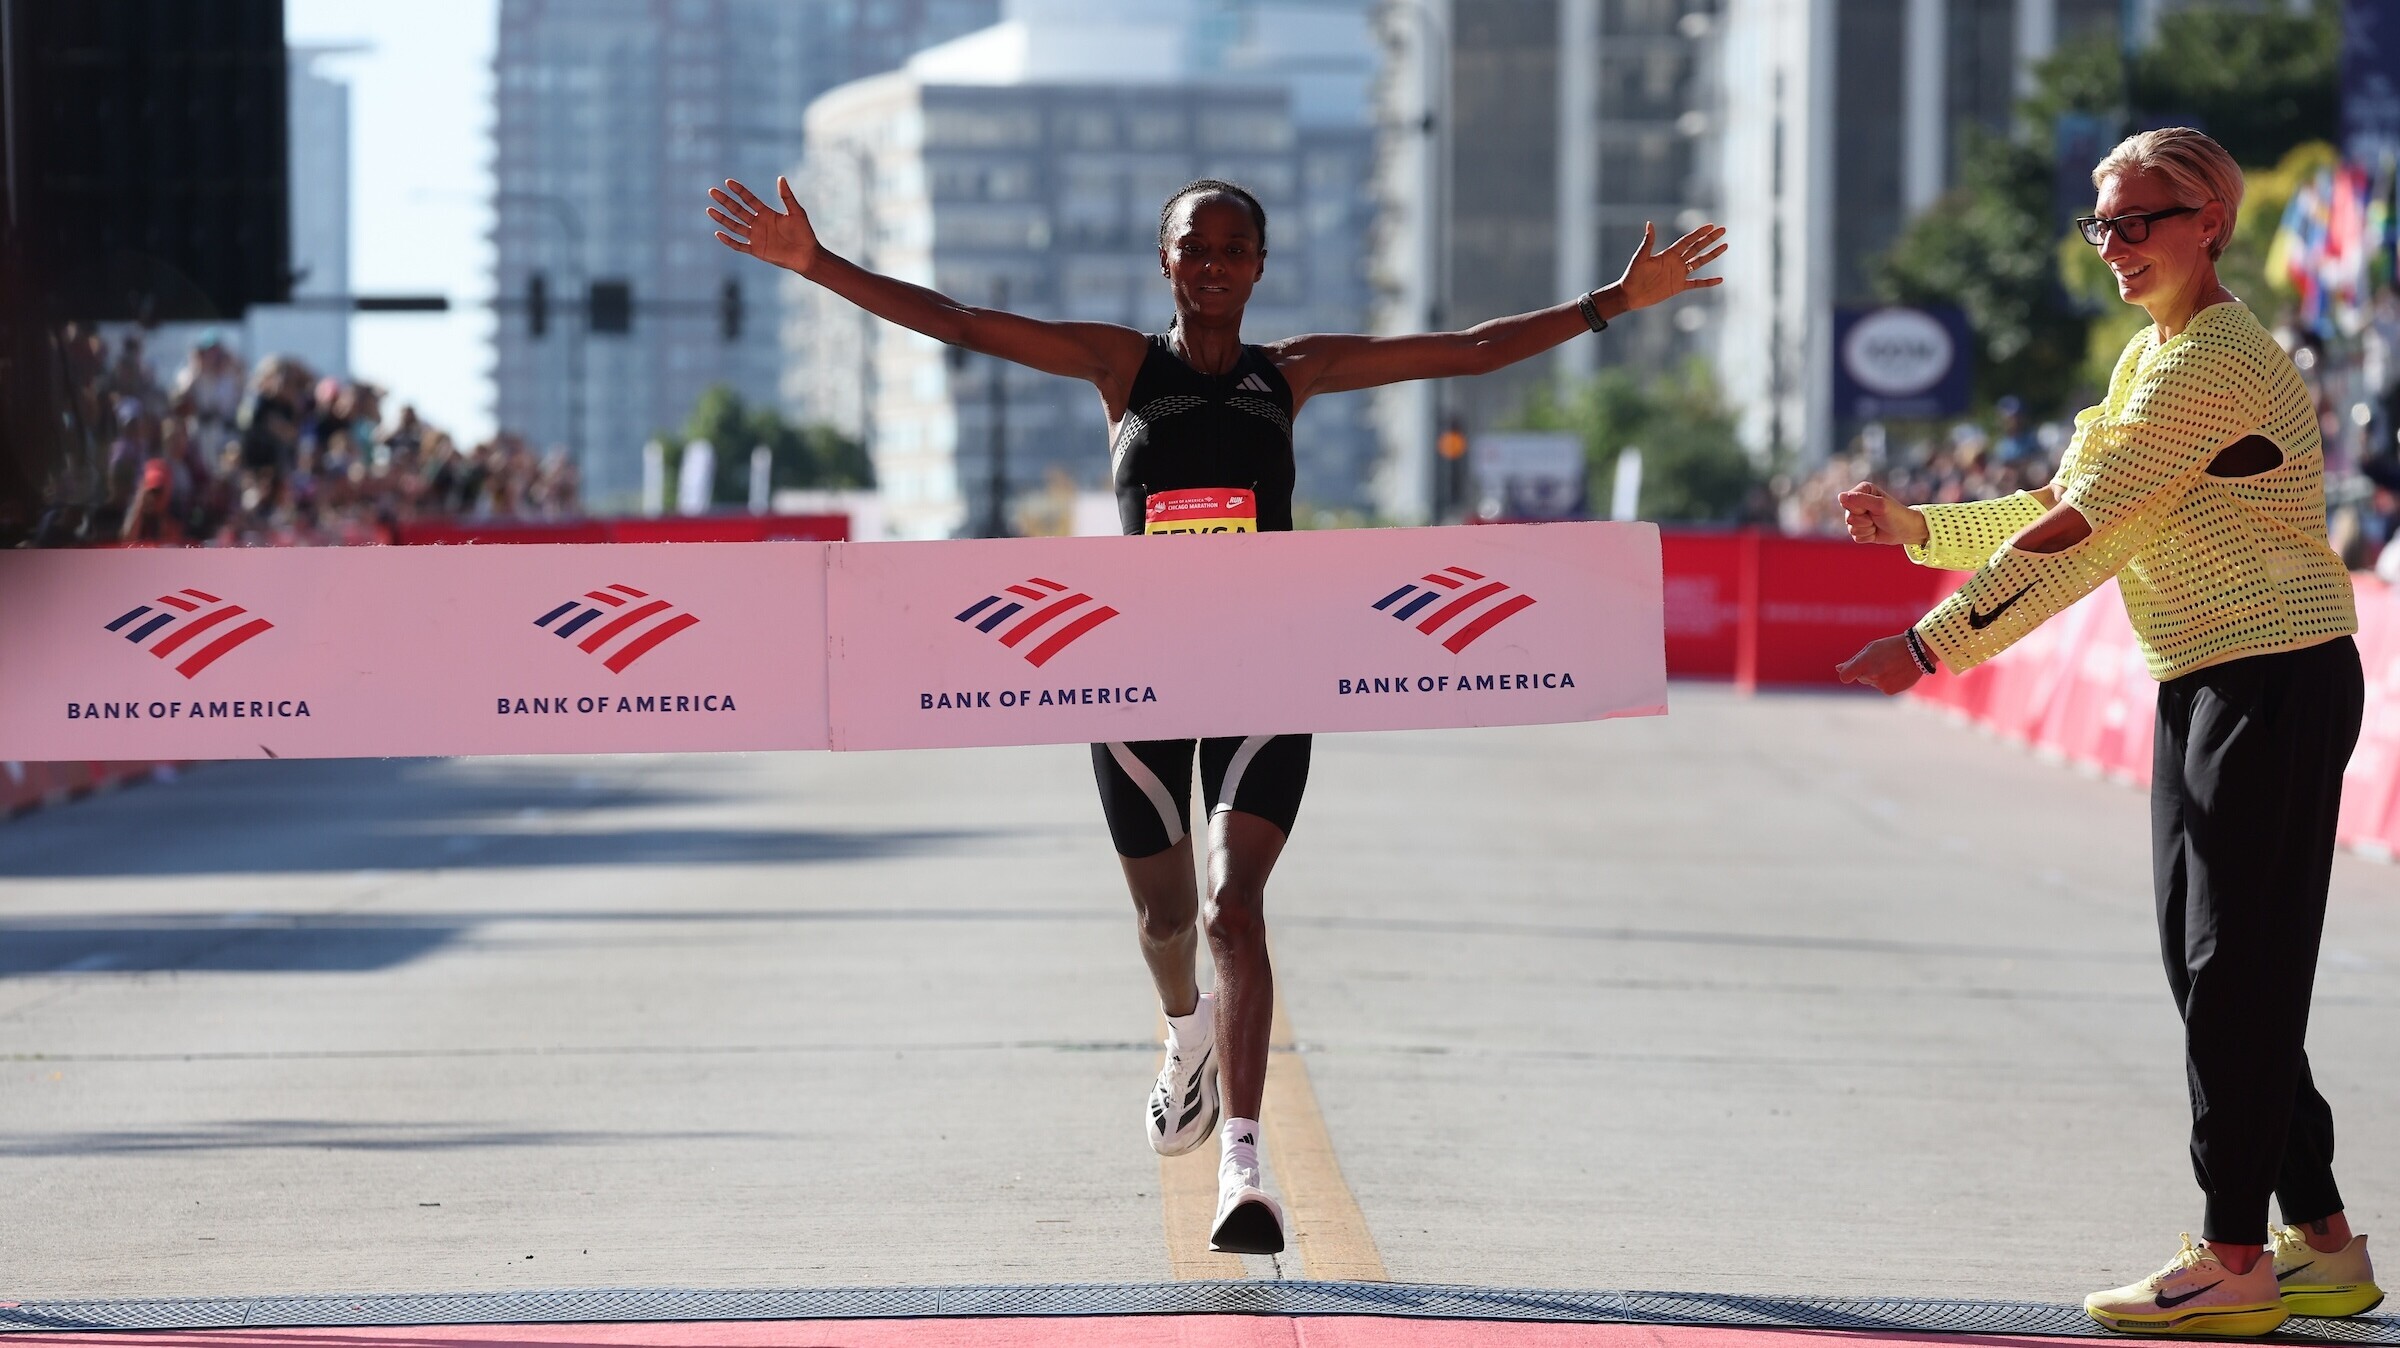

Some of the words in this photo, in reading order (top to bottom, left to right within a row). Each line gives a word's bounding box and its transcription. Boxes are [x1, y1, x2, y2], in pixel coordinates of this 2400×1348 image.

[1189, 502, 1218, 510] MARATHON
[1339, 677, 1410, 695] BANK
[1418, 676, 1449, 693] OF
[1457, 673, 1576, 691] AMERICA
[498, 698, 569, 714] BANK
[577, 697, 609, 713] OF
[617, 696, 736, 713] AMERICA
[921, 692, 991, 710] BANK
[1000, 691, 1031, 708] OF
[1039, 687, 1158, 706] AMERICA
[68, 703, 140, 719] BANK
[149, 702, 182, 718] OF
[189, 701, 311, 718] AMERICA
